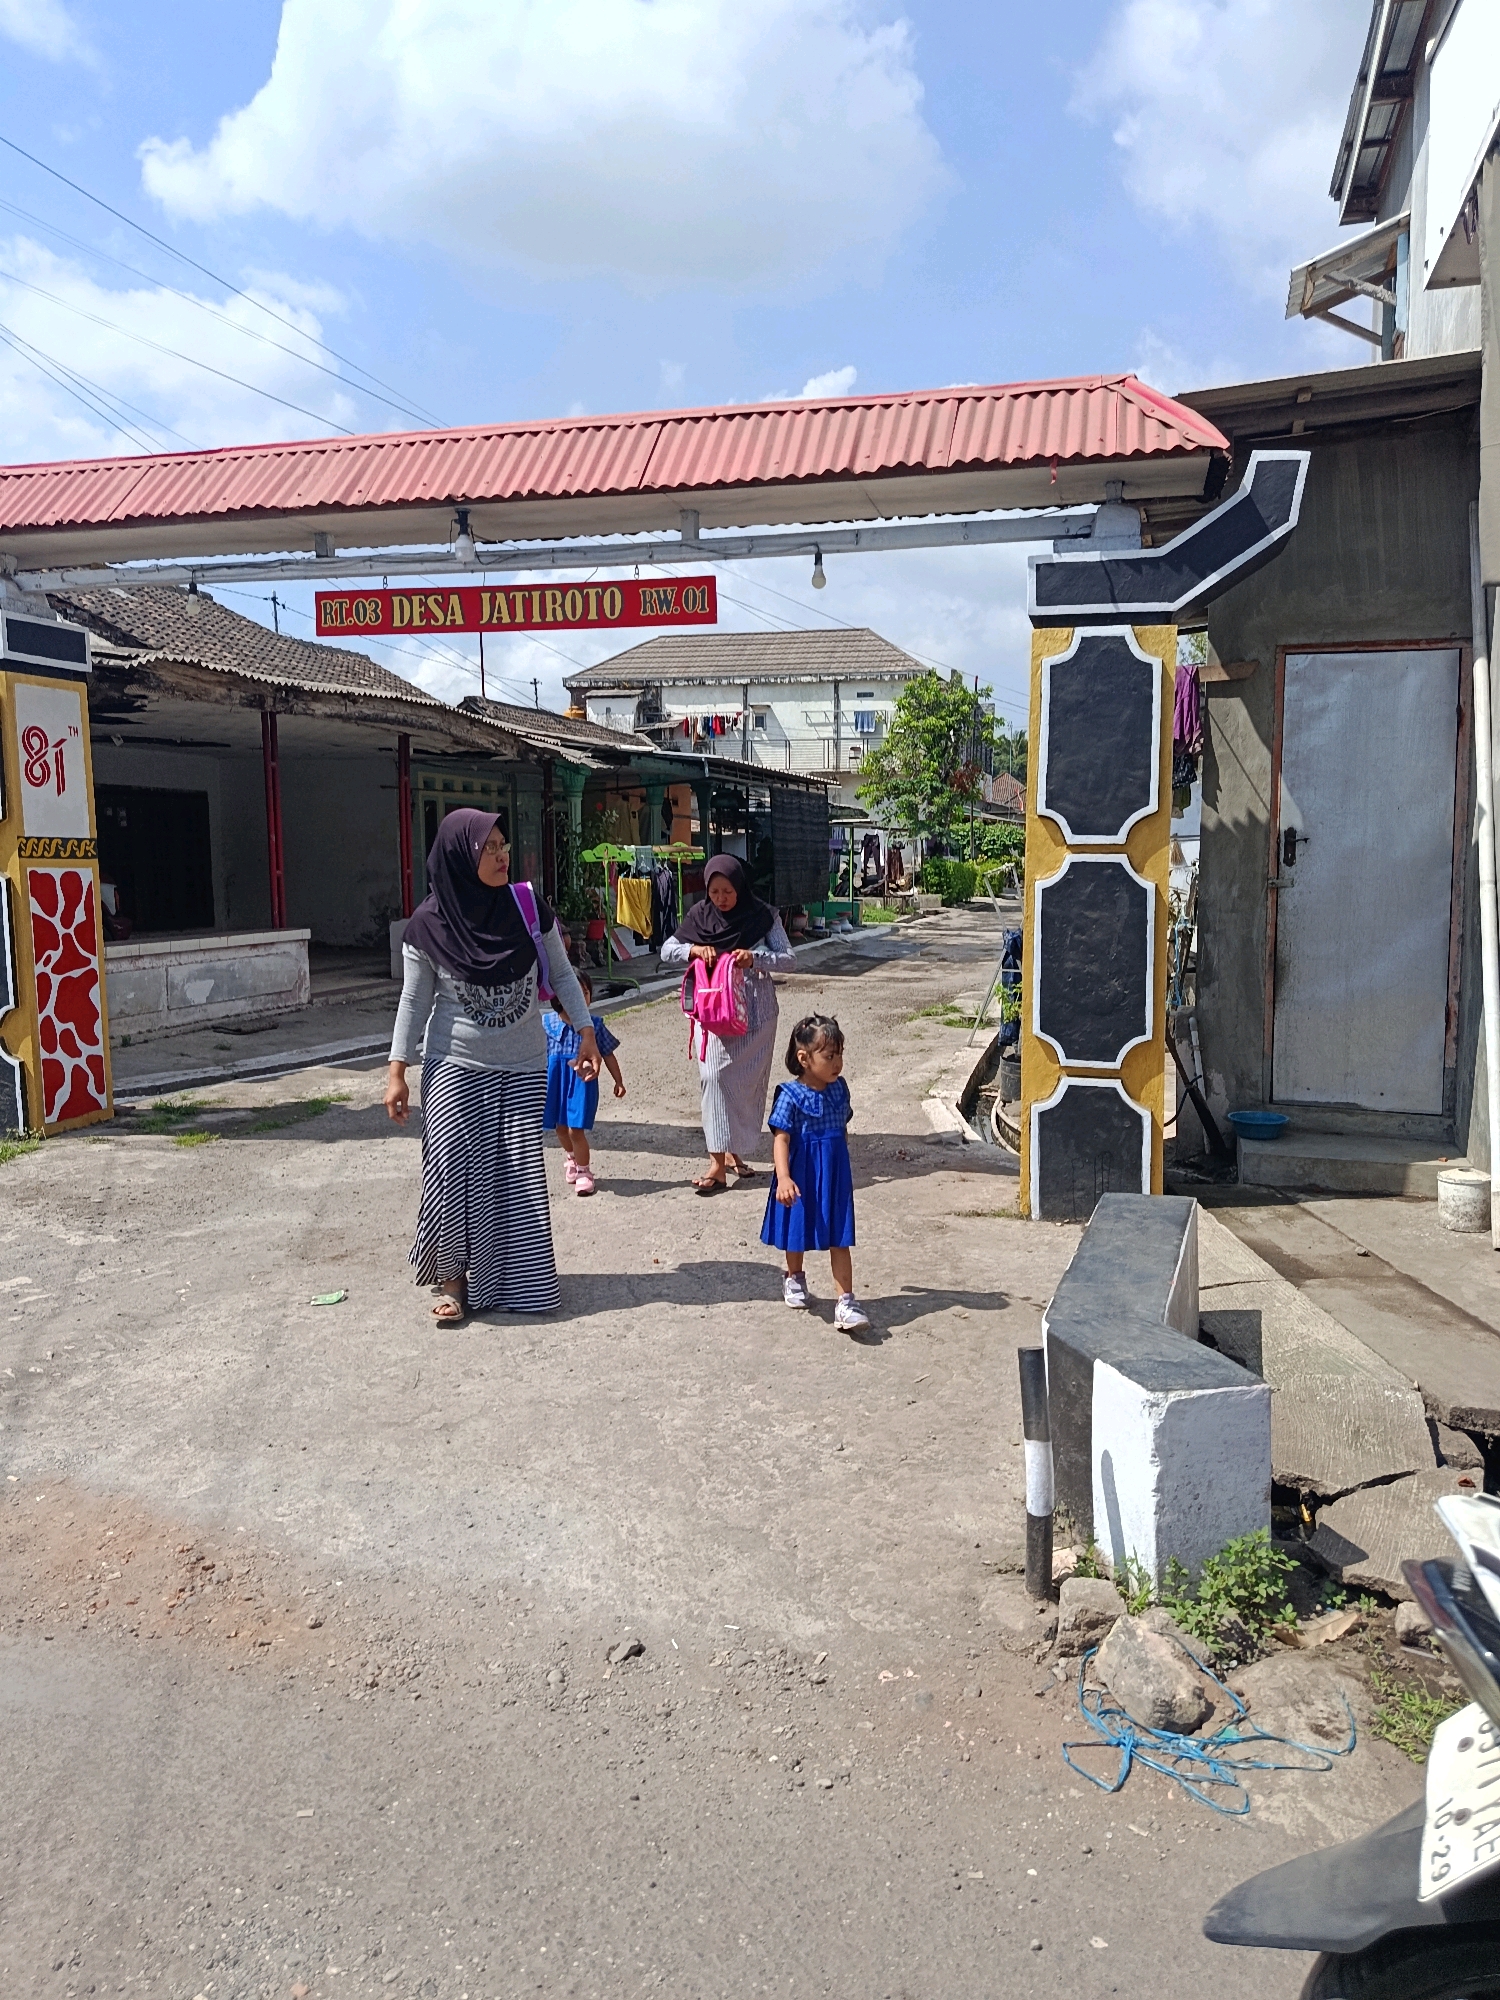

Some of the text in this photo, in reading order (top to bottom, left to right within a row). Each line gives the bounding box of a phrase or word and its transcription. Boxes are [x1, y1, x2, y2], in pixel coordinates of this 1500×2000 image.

[320, 597, 382, 627] RT.03
[391, 593, 465, 627] DESA
[479, 586, 623, 625] JATIROTO
[484, 983, 513, 998] YES
